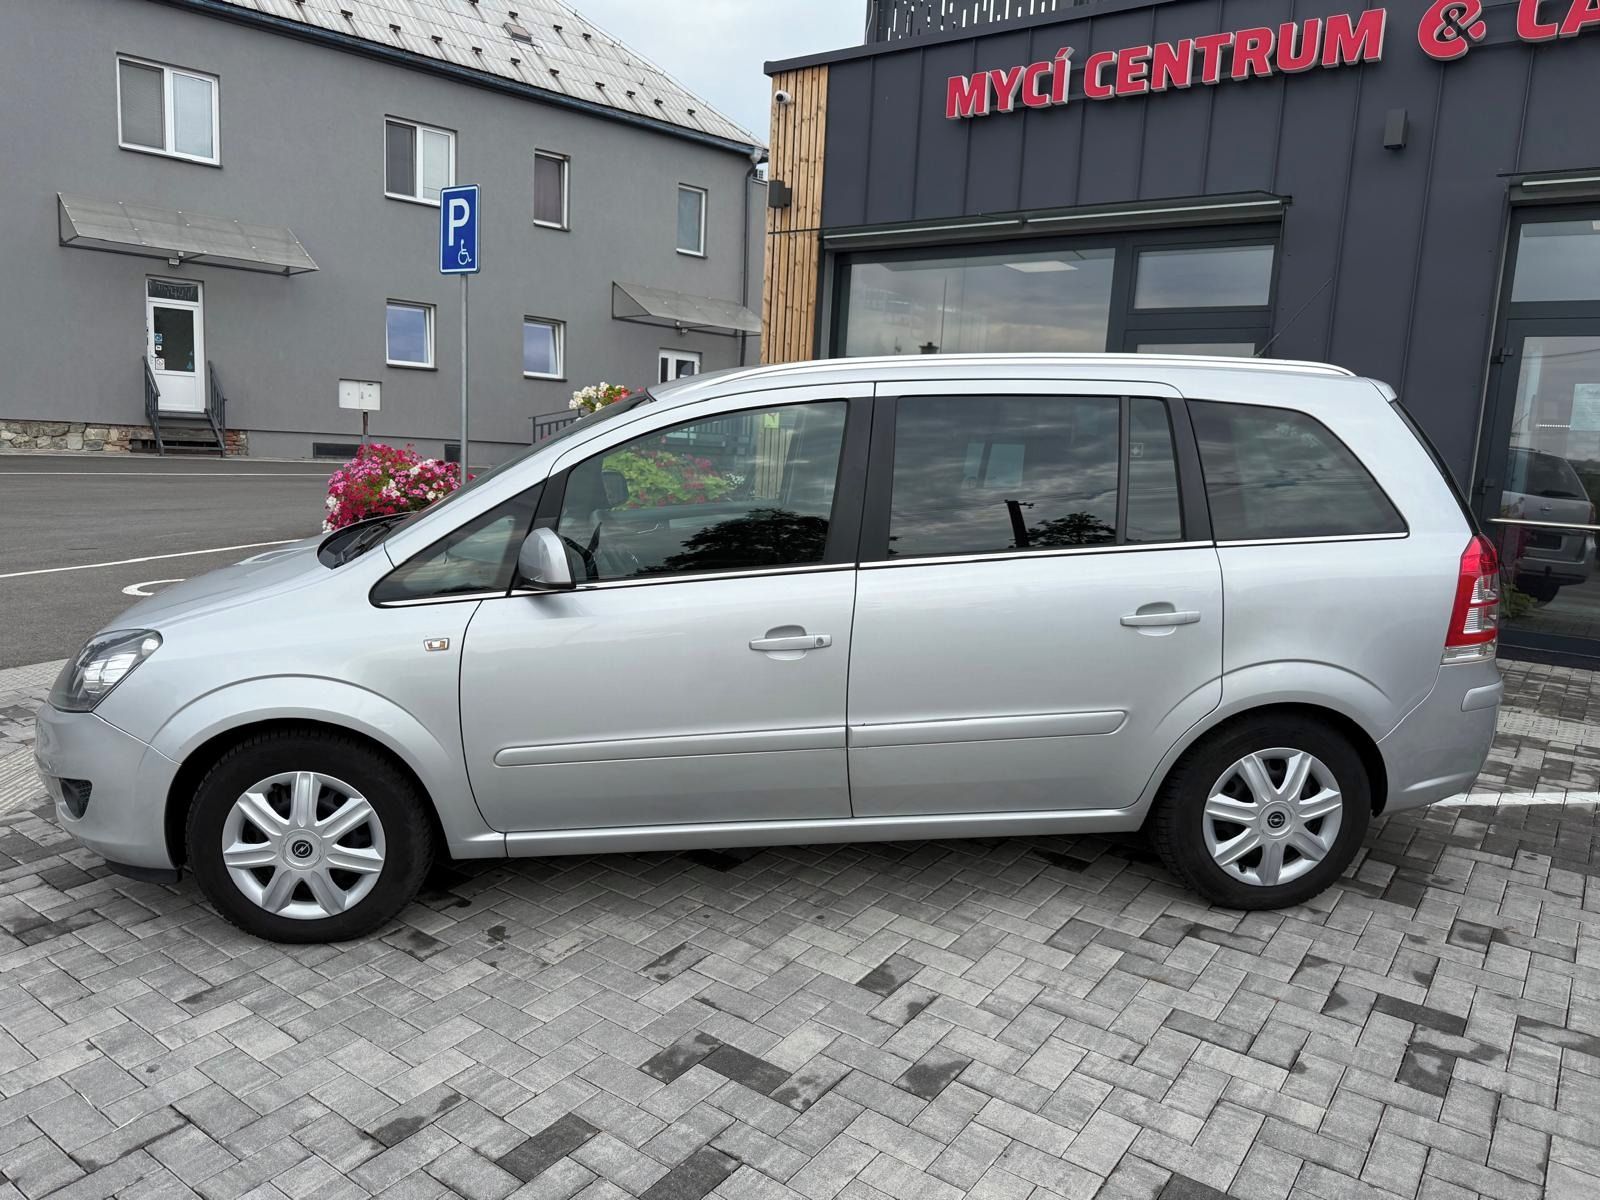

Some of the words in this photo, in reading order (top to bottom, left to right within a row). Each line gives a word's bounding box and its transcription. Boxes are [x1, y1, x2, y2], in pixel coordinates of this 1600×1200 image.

[946, 47, 1074, 119] MYCÍ
[1083, 8, 1386, 99] CENTRUM
[1417, 0, 1487, 60] &
[448, 198, 470, 246] P
